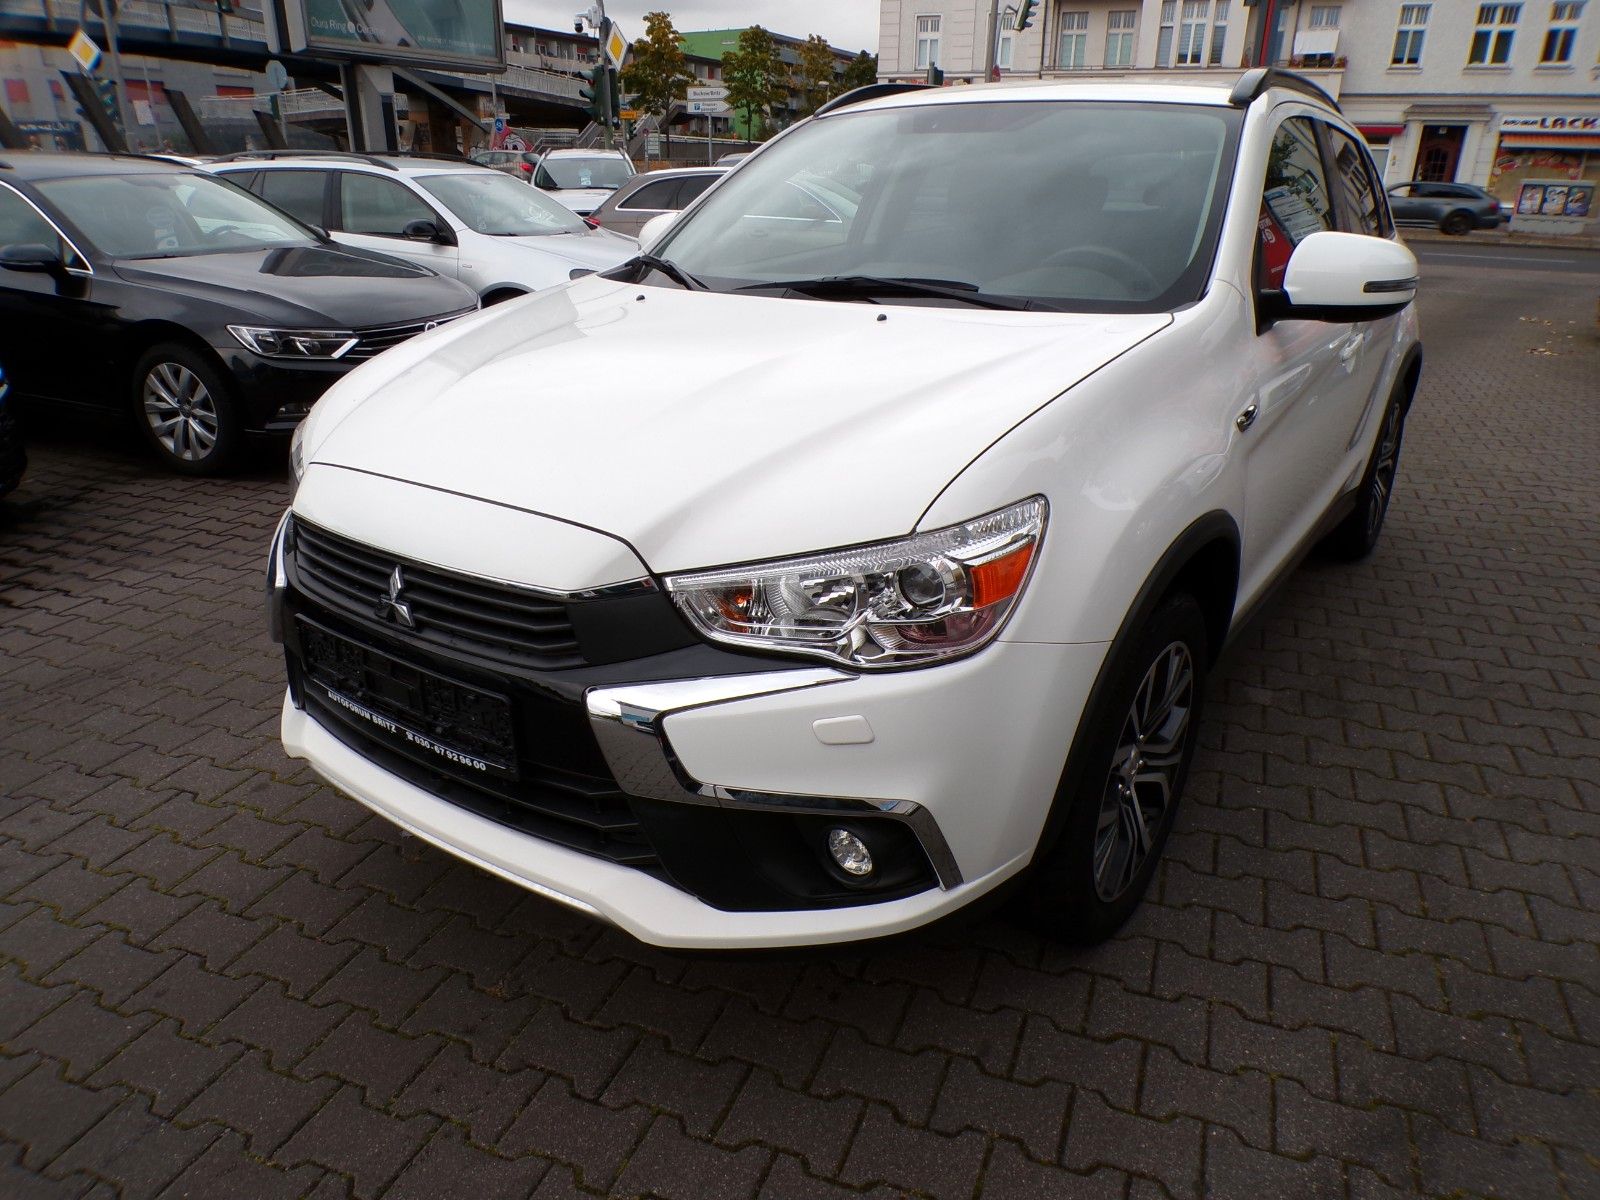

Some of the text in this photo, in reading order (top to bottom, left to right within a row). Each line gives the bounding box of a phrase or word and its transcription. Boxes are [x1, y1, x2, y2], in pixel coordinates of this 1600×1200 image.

[329, 20, 347, 33] Ring
[1539, 117, 1599, 129] LACK
[327, 691, 371, 721] AUTOFORUM
[372, 715, 397, 734] BRITZ
[446, 751, 459, 762] 92
[473, 760, 487, 771] 00
